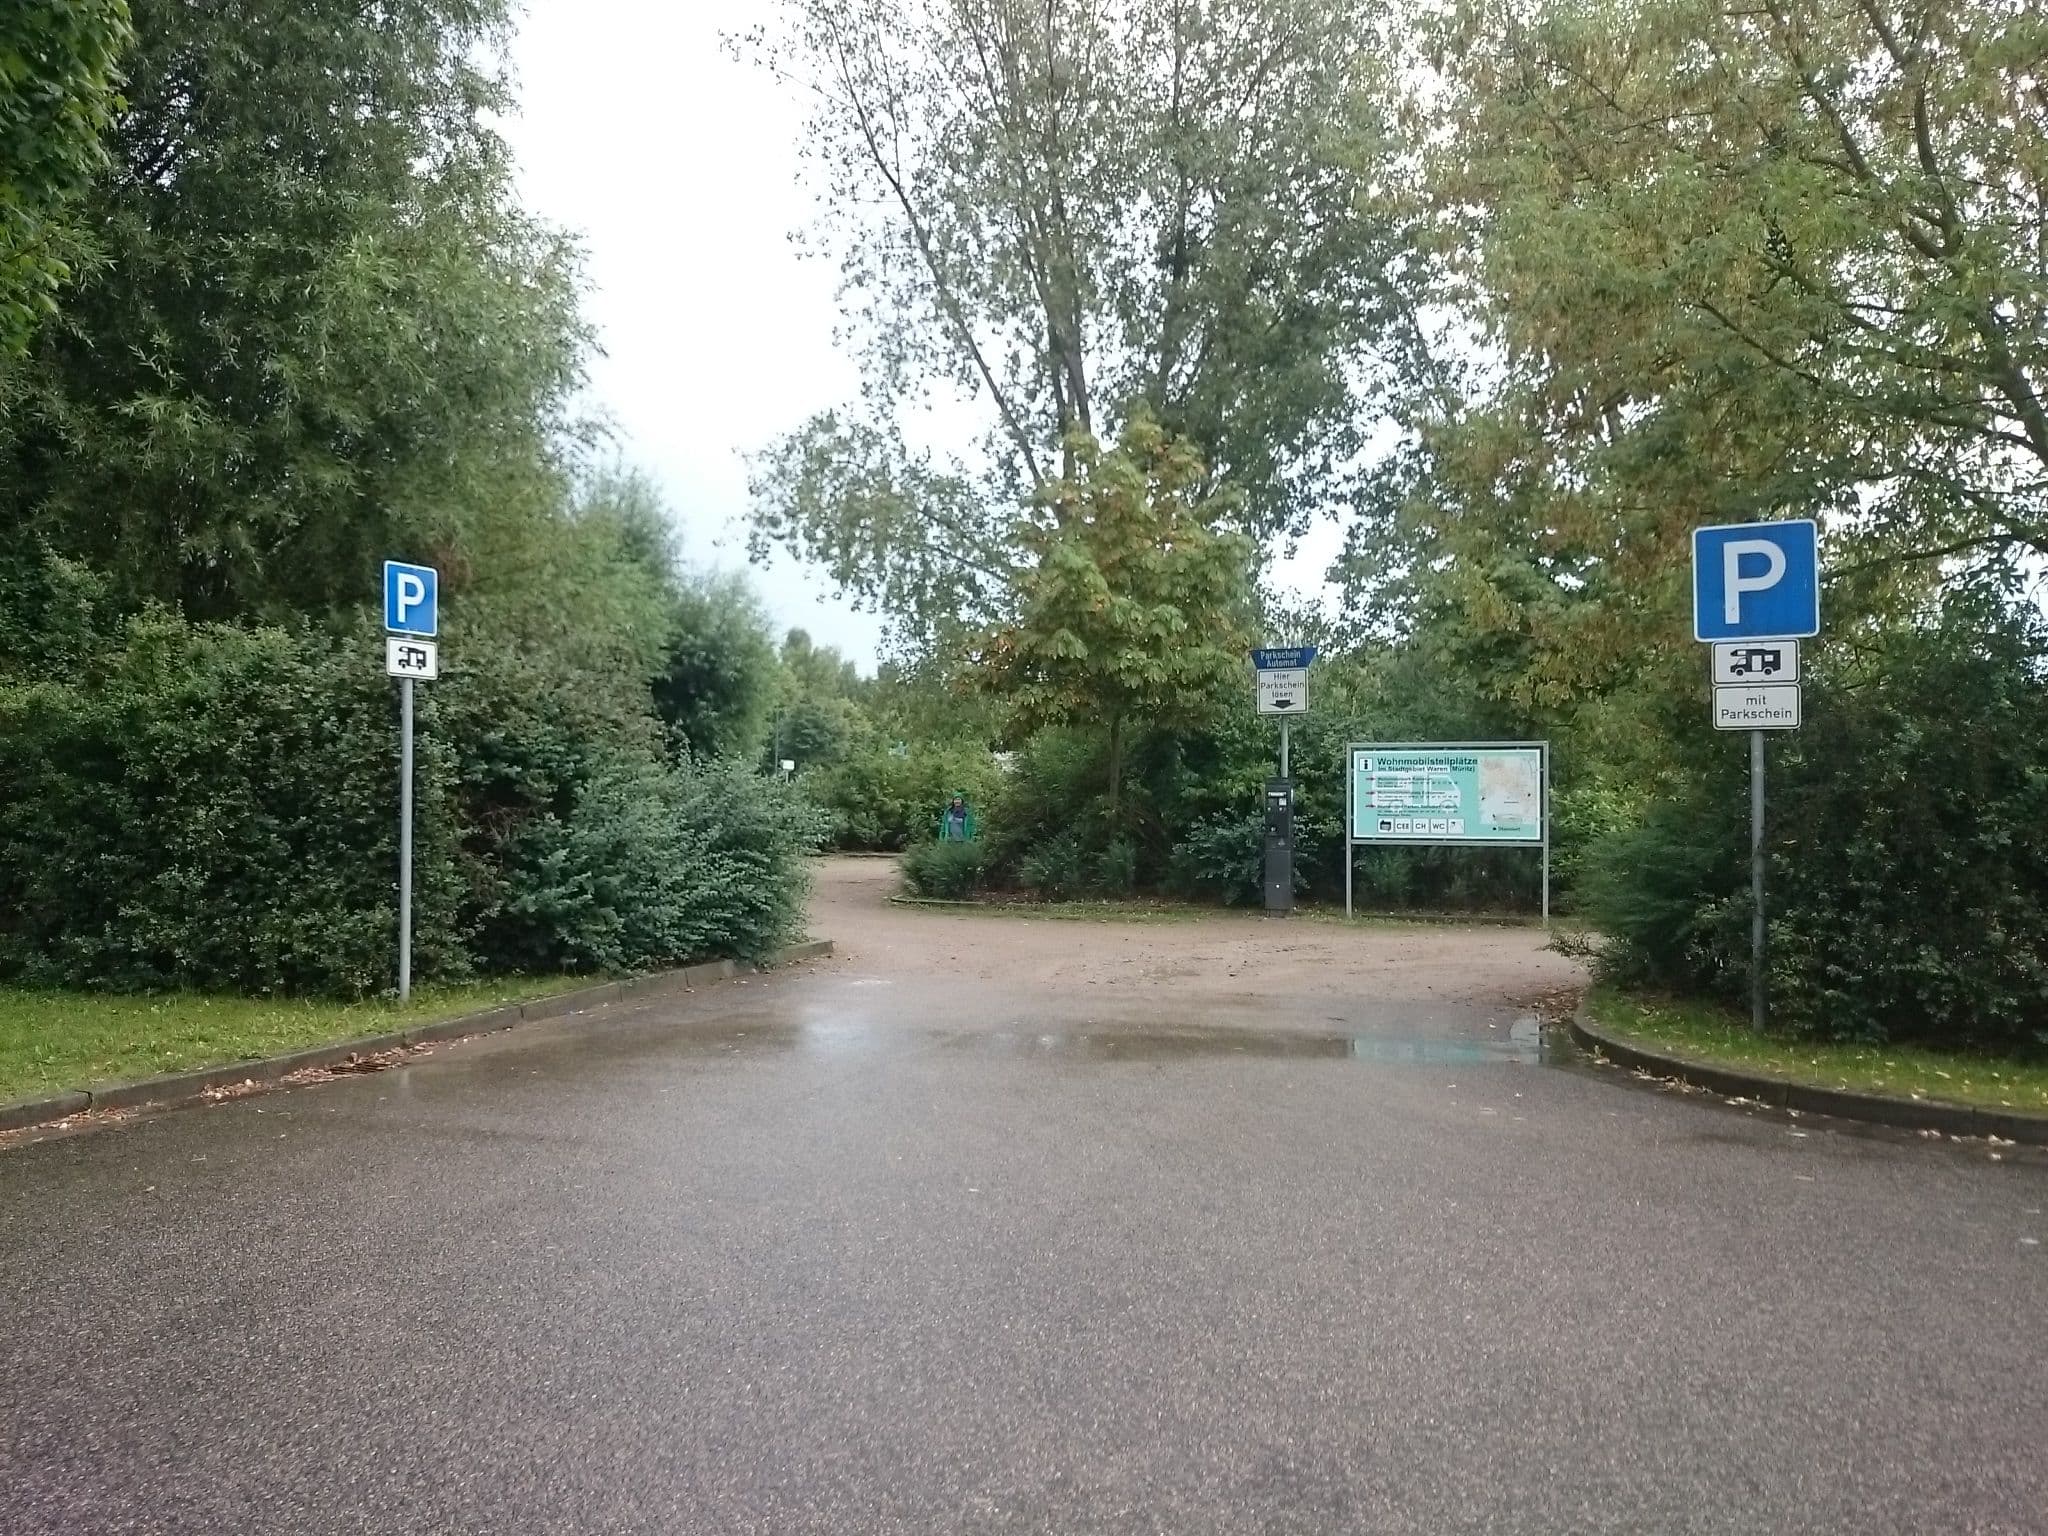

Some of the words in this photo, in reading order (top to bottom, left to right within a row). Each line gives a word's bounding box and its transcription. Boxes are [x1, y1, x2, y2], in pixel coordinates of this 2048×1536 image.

[1723, 539, 1787, 625] P
[397, 572, 425, 623] P
[1260, 650, 1301, 660] Parkschein
[1266, 658, 1298, 667] Automat
[1260, 681, 1305, 689] Parkschein
[1746, 695, 1766, 706] mit
[1721, 708, 1792, 720] Parkschein
[1377, 757, 1478, 768] Wohnmobilstellplätze
